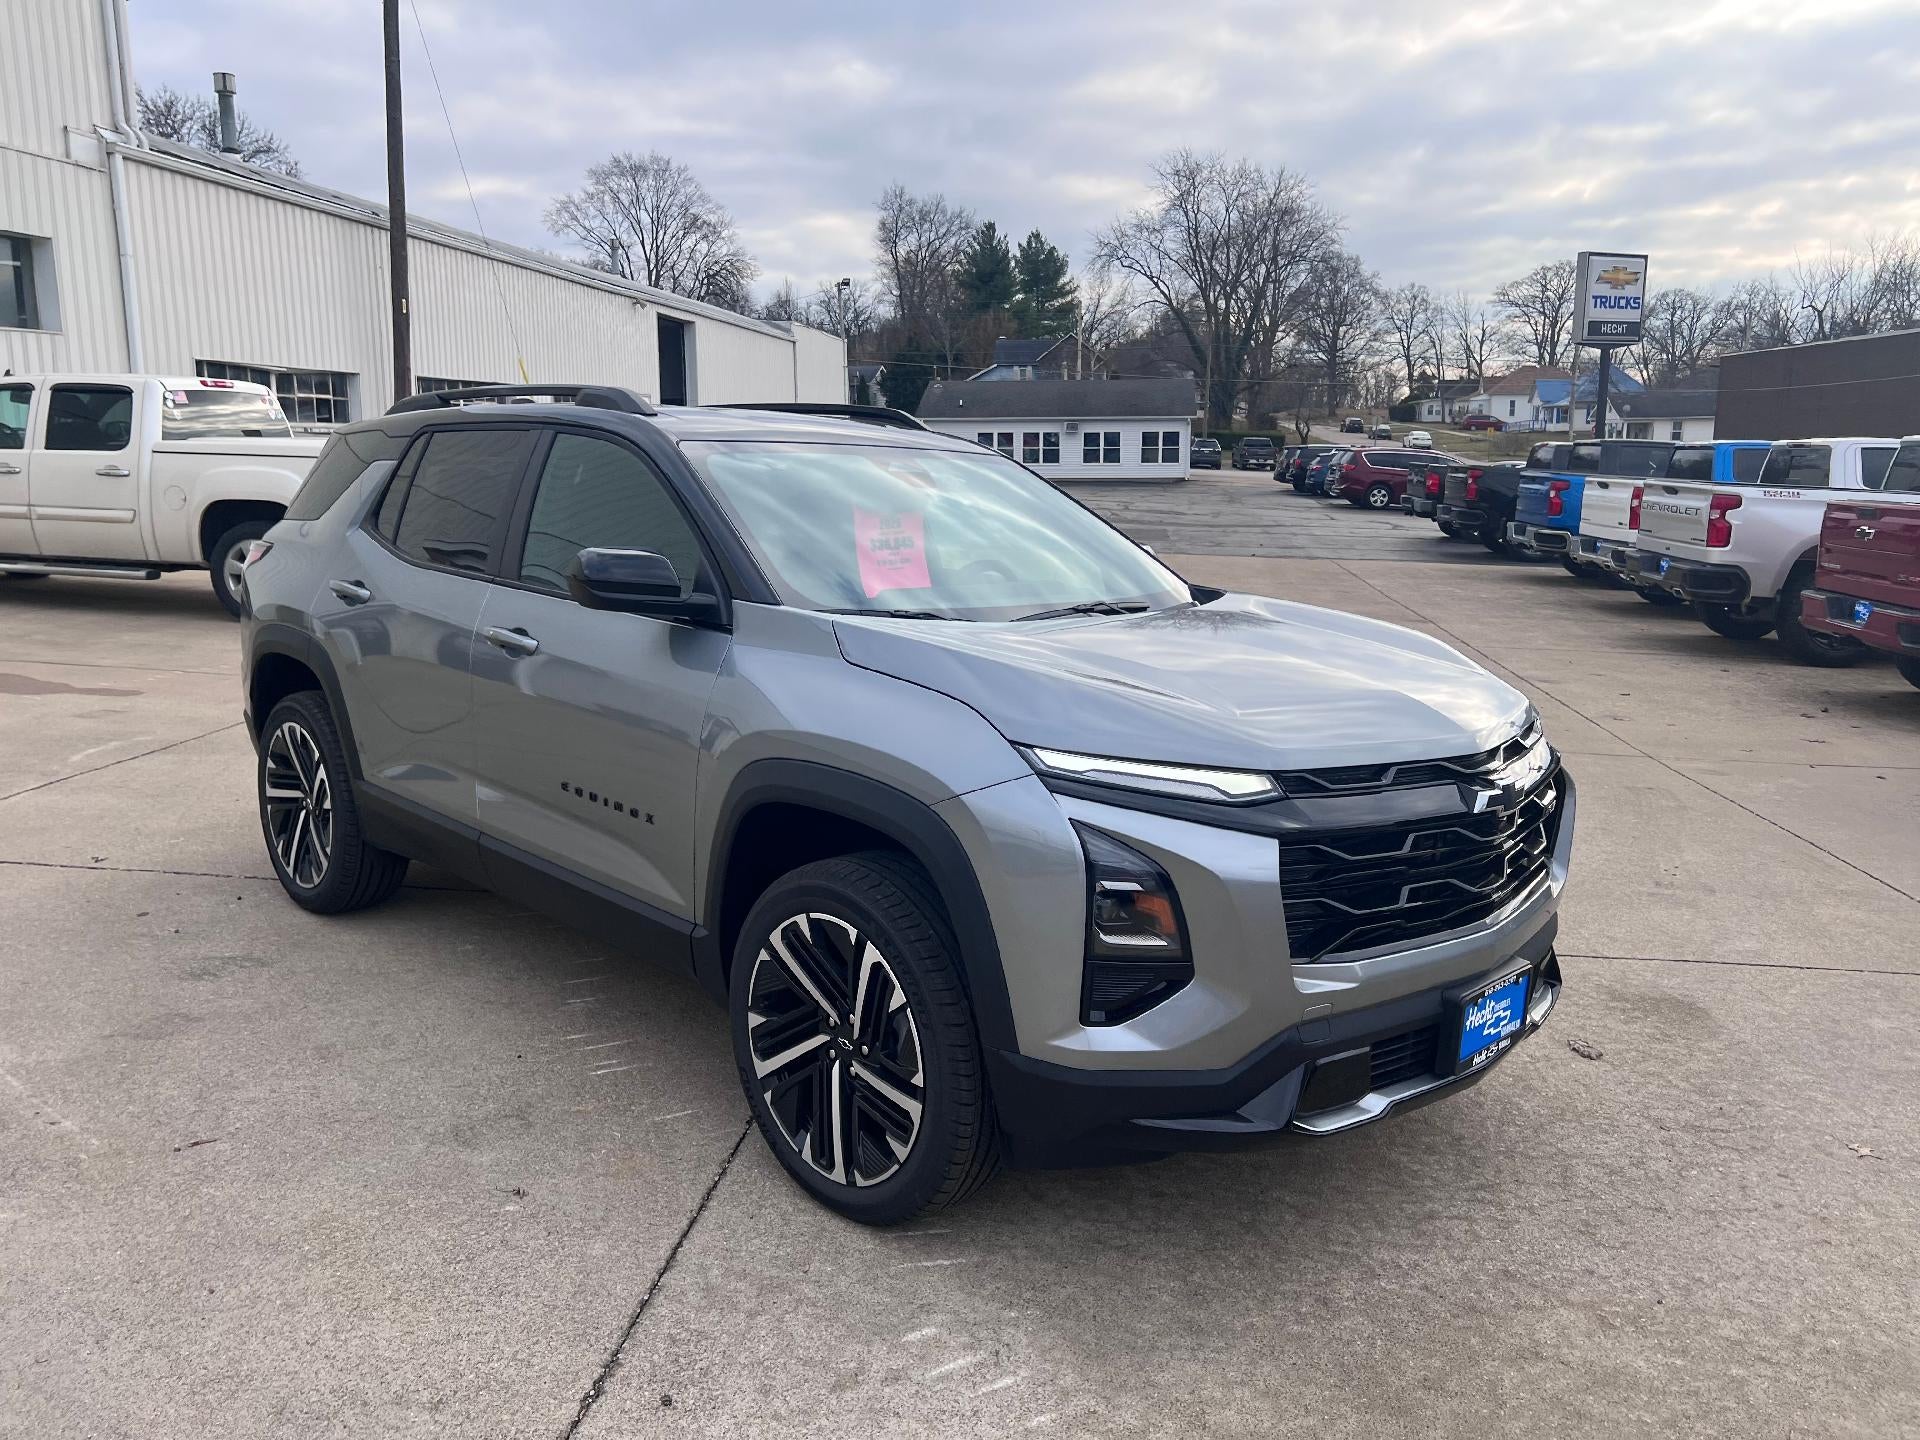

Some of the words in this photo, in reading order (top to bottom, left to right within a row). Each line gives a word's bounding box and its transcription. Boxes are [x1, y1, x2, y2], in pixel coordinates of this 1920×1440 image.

[1591, 295, 1641, 310] TRUCKS
[1600, 323, 1628, 334] HECHT
[1641, 501, 1702, 517] CHEVROLET
[560, 781, 655, 826] EQUINOX
[1466, 998, 1496, 1032] Hecht
